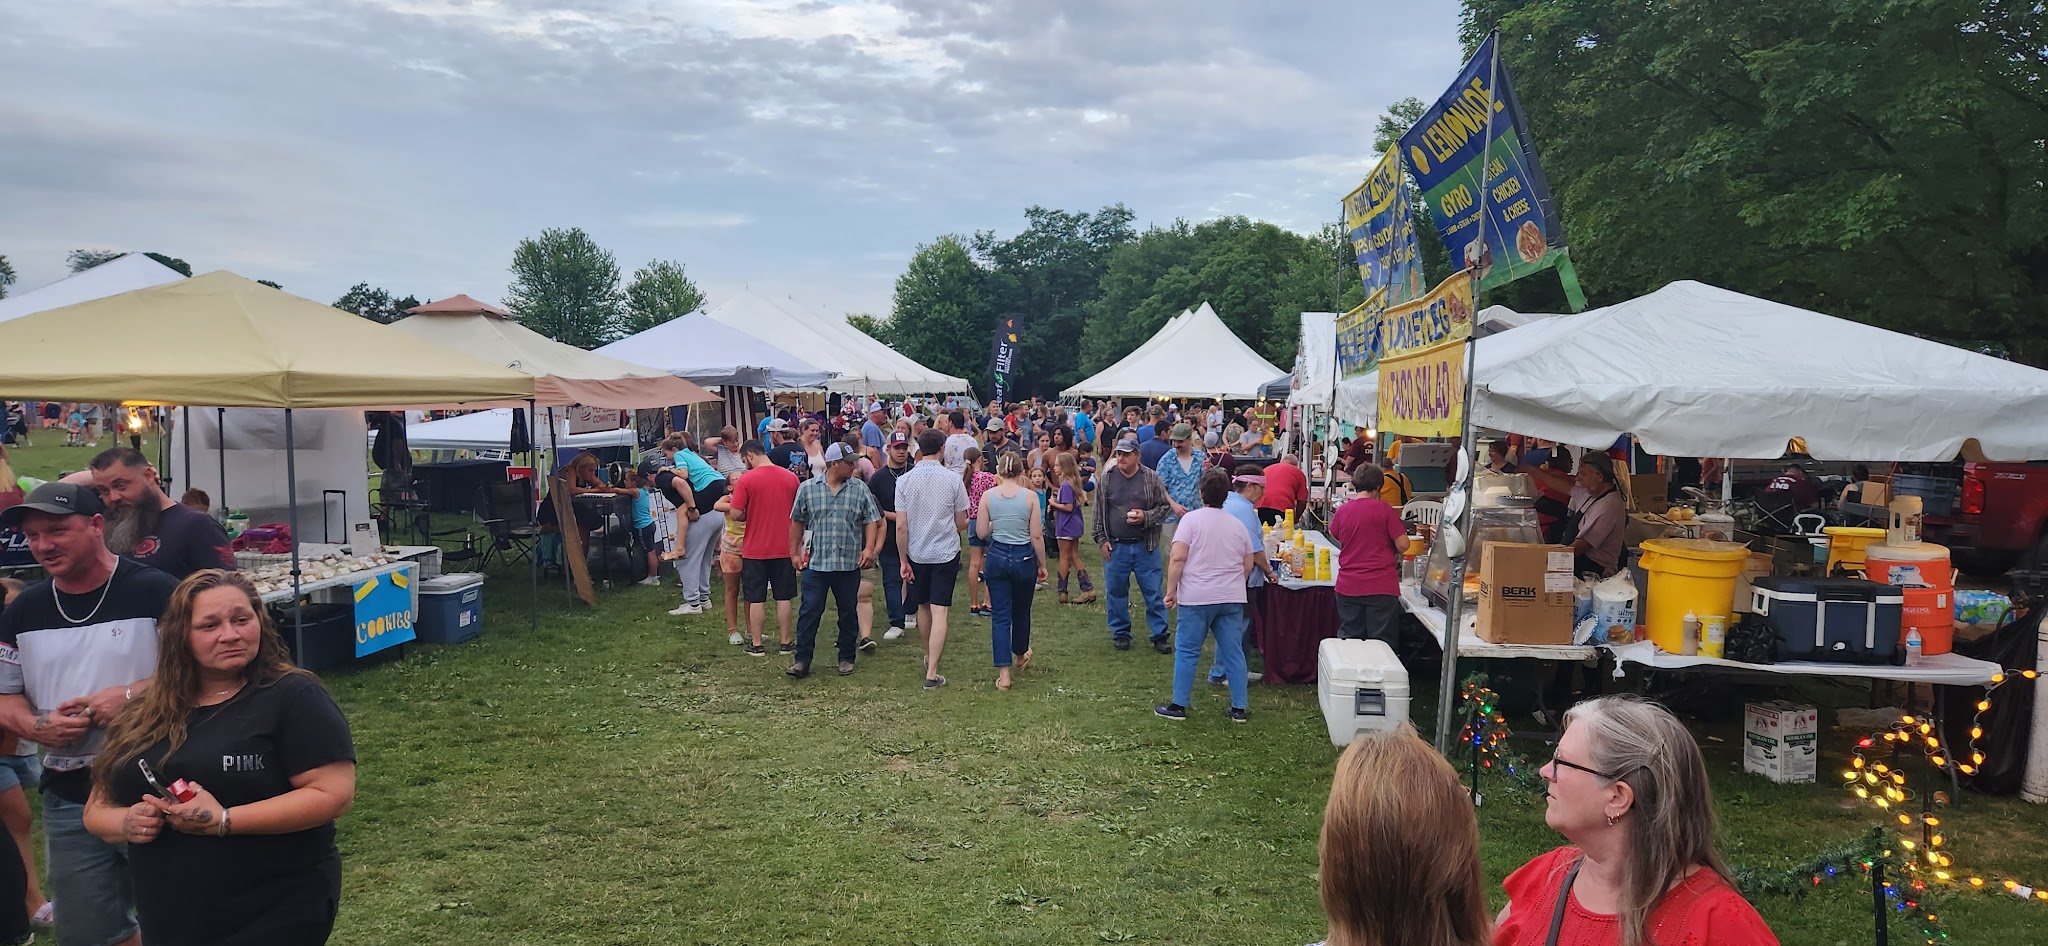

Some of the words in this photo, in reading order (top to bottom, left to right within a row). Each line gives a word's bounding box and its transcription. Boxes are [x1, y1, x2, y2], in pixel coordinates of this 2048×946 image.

[1421, 76, 1504, 164] LEMONADE
[1440, 183, 1473, 218] GYRO
[1492, 175, 1522, 204] CHICKEN
[1507, 197, 1531, 220] CHEESE
[996, 339, 1008, 373] Filter
[1390, 367, 1414, 420] TACO
[1416, 360, 1450, 420] SALAD
[54, 495, 68, 503] UA
[1502, 586, 1537, 596] BERK
[356, 610, 412, 644] COOKIES
[223, 753, 265, 772] PINK
